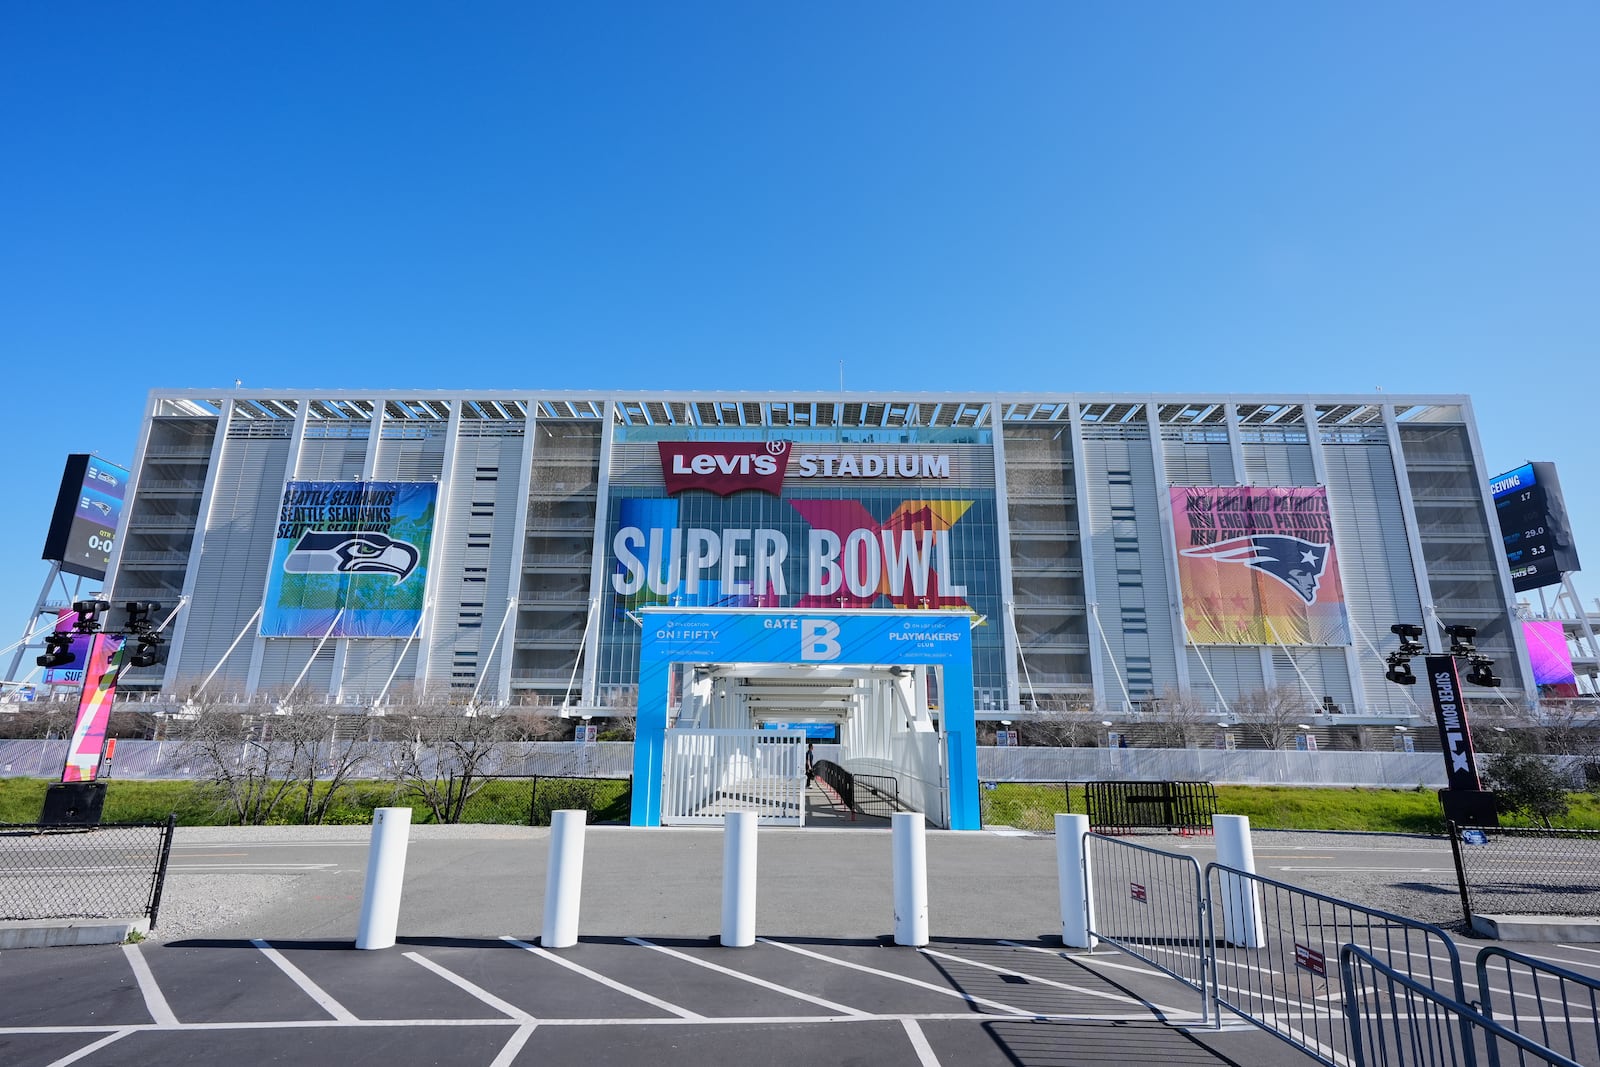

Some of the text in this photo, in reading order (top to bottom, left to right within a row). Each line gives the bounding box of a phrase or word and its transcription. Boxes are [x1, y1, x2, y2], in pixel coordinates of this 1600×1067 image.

[799, 454, 950, 478] STADIUM
[283, 490, 395, 506] SEATTLE SEAHAWKS
[1186, 495, 1329, 512] NEW ENGLAND PATRIOTS
[1520, 491, 1531, 502] 17
[280, 506, 391, 523] SEATTLE SEAHAWKS
[1188, 512, 1332, 529] NEW ENGLAND PATRIOTS
[1190, 529, 1218, 546] NEW
[1524, 526, 1545, 539] 29.0
[1531, 544, 1546, 556] 3.3
[611, 526, 968, 598] SUPER BOWL
[656, 630, 675, 639] ON
[683, 630, 719, 639] FIFTY
[763, 618, 842, 661] GATE B
[889, 632, 962, 641] PLAYMAKERS'
[1434, 672, 1470, 773] SUPER BOWL LX
